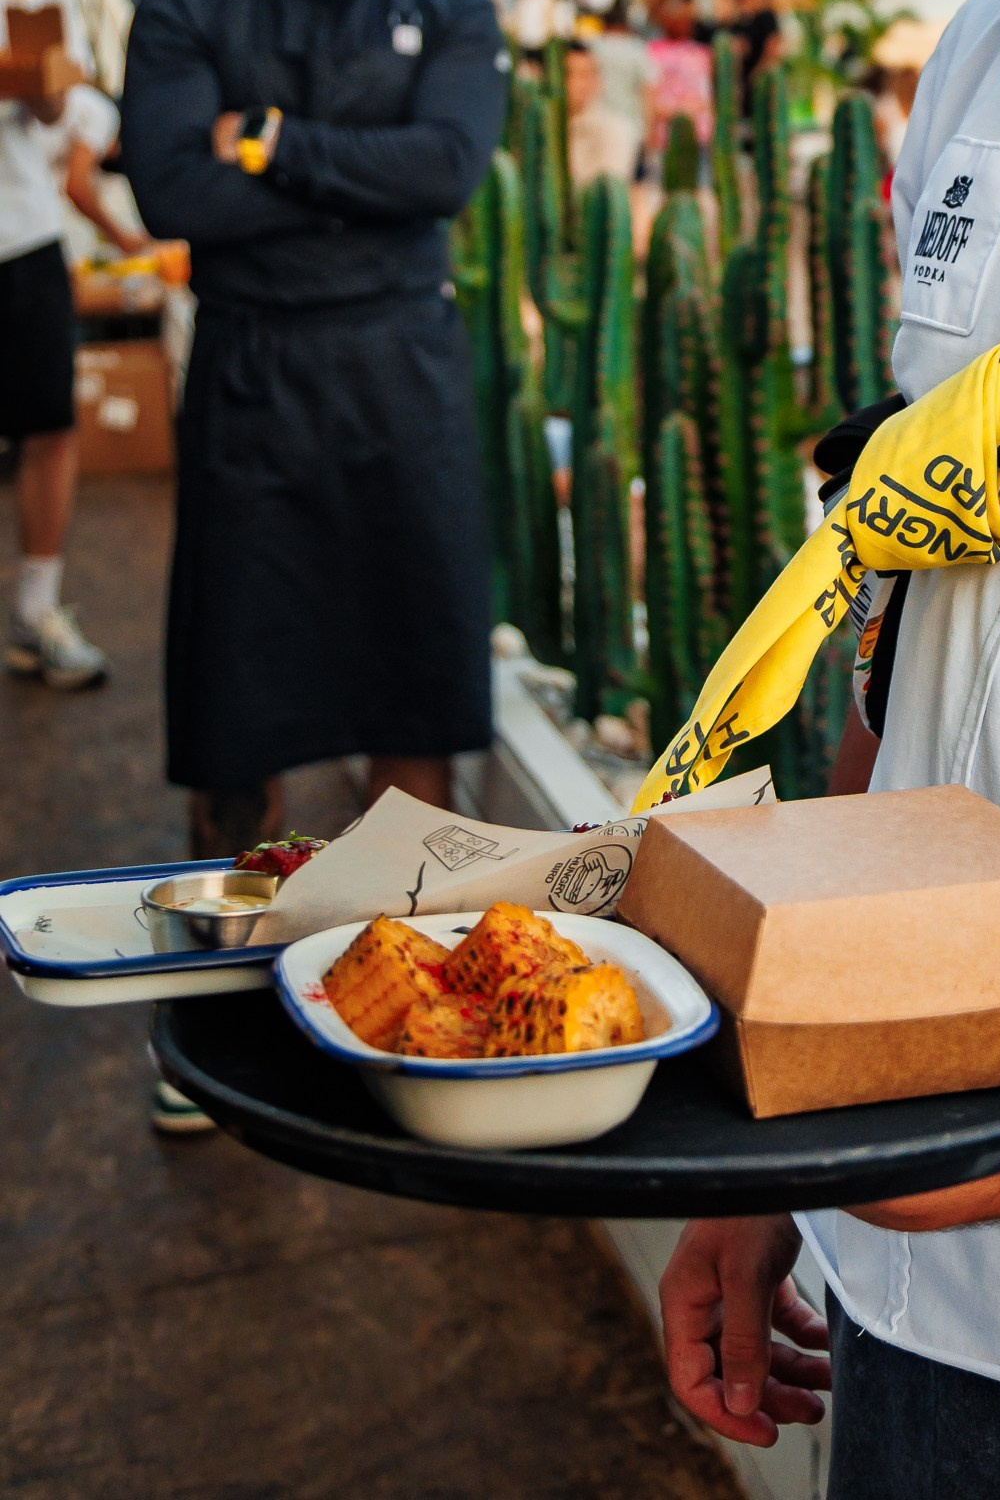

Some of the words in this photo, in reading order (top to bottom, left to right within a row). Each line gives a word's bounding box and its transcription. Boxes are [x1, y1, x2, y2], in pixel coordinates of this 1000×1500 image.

[923, 455, 986, 518] IRD
[544, 862, 564, 884] BIRD
[553, 856, 582, 899] HUNGRY
